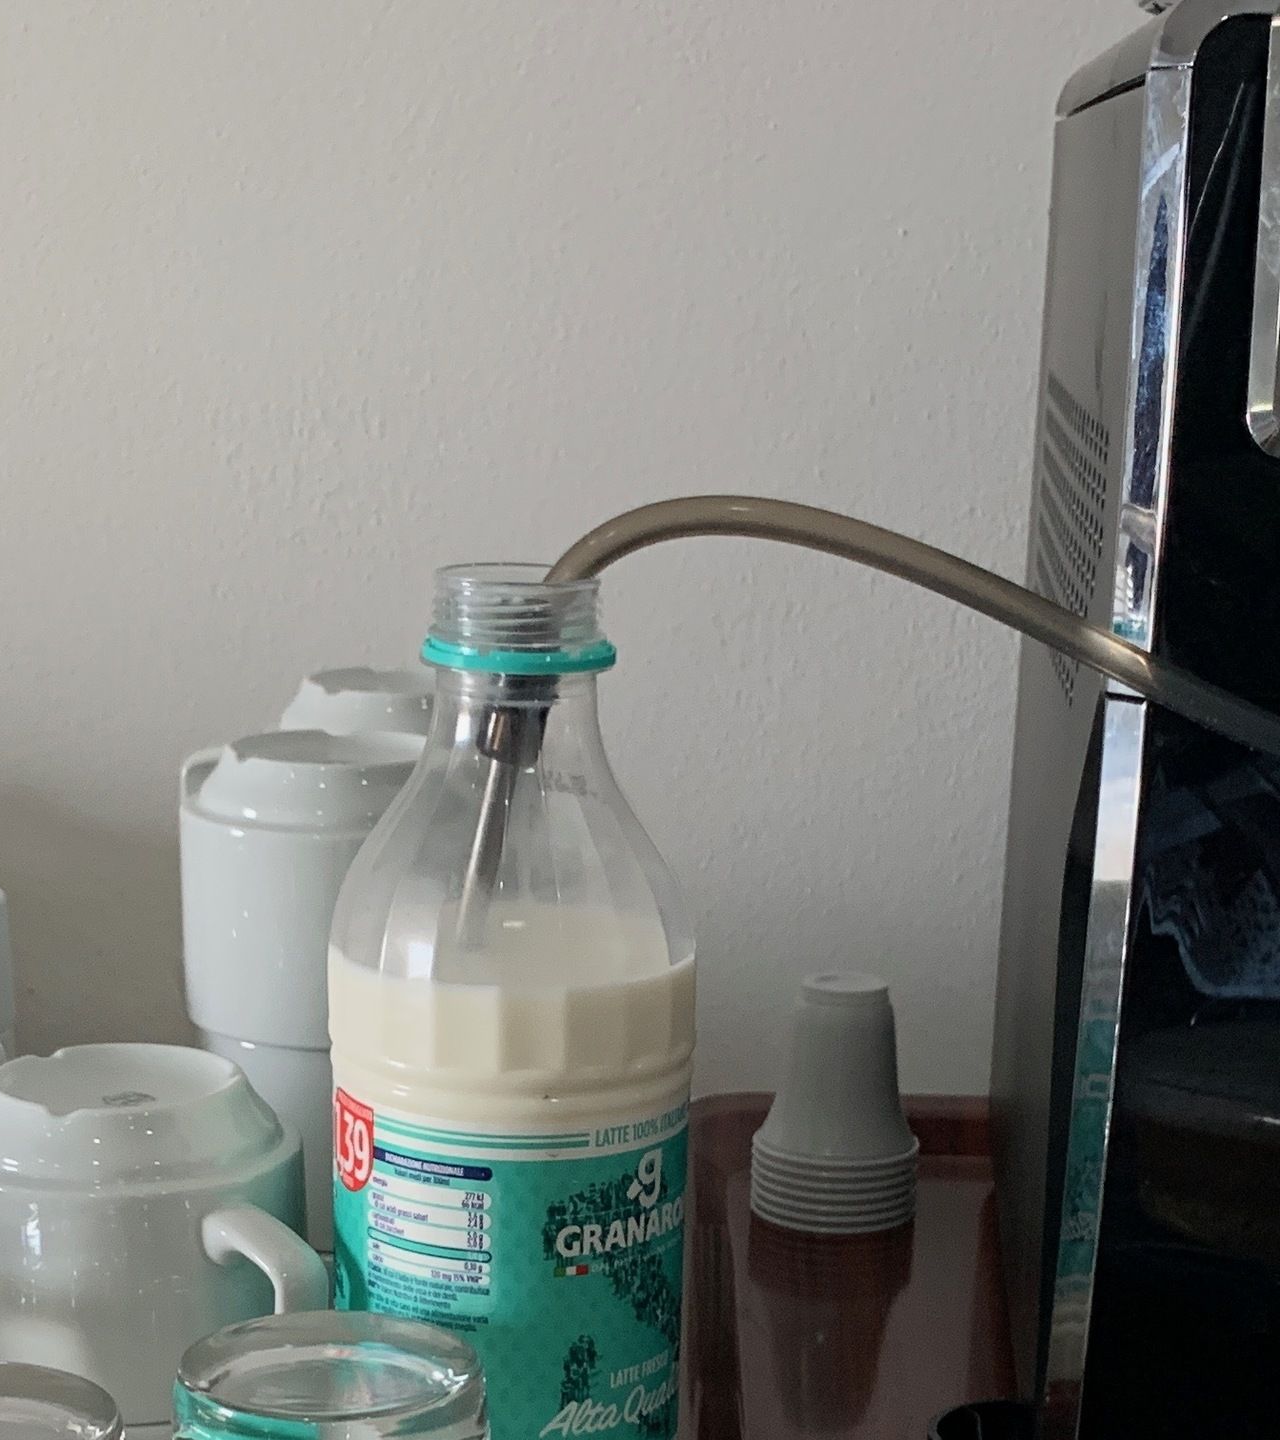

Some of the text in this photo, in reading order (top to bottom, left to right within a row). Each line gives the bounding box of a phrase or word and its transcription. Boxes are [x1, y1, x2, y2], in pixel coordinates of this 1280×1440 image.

[595, 1125, 630, 1148] LATTE
[632, 1118, 658, 1142] 100%
[609, 1363, 641, 1390] LATTE
[538, 1397, 624, 1440] Alta
